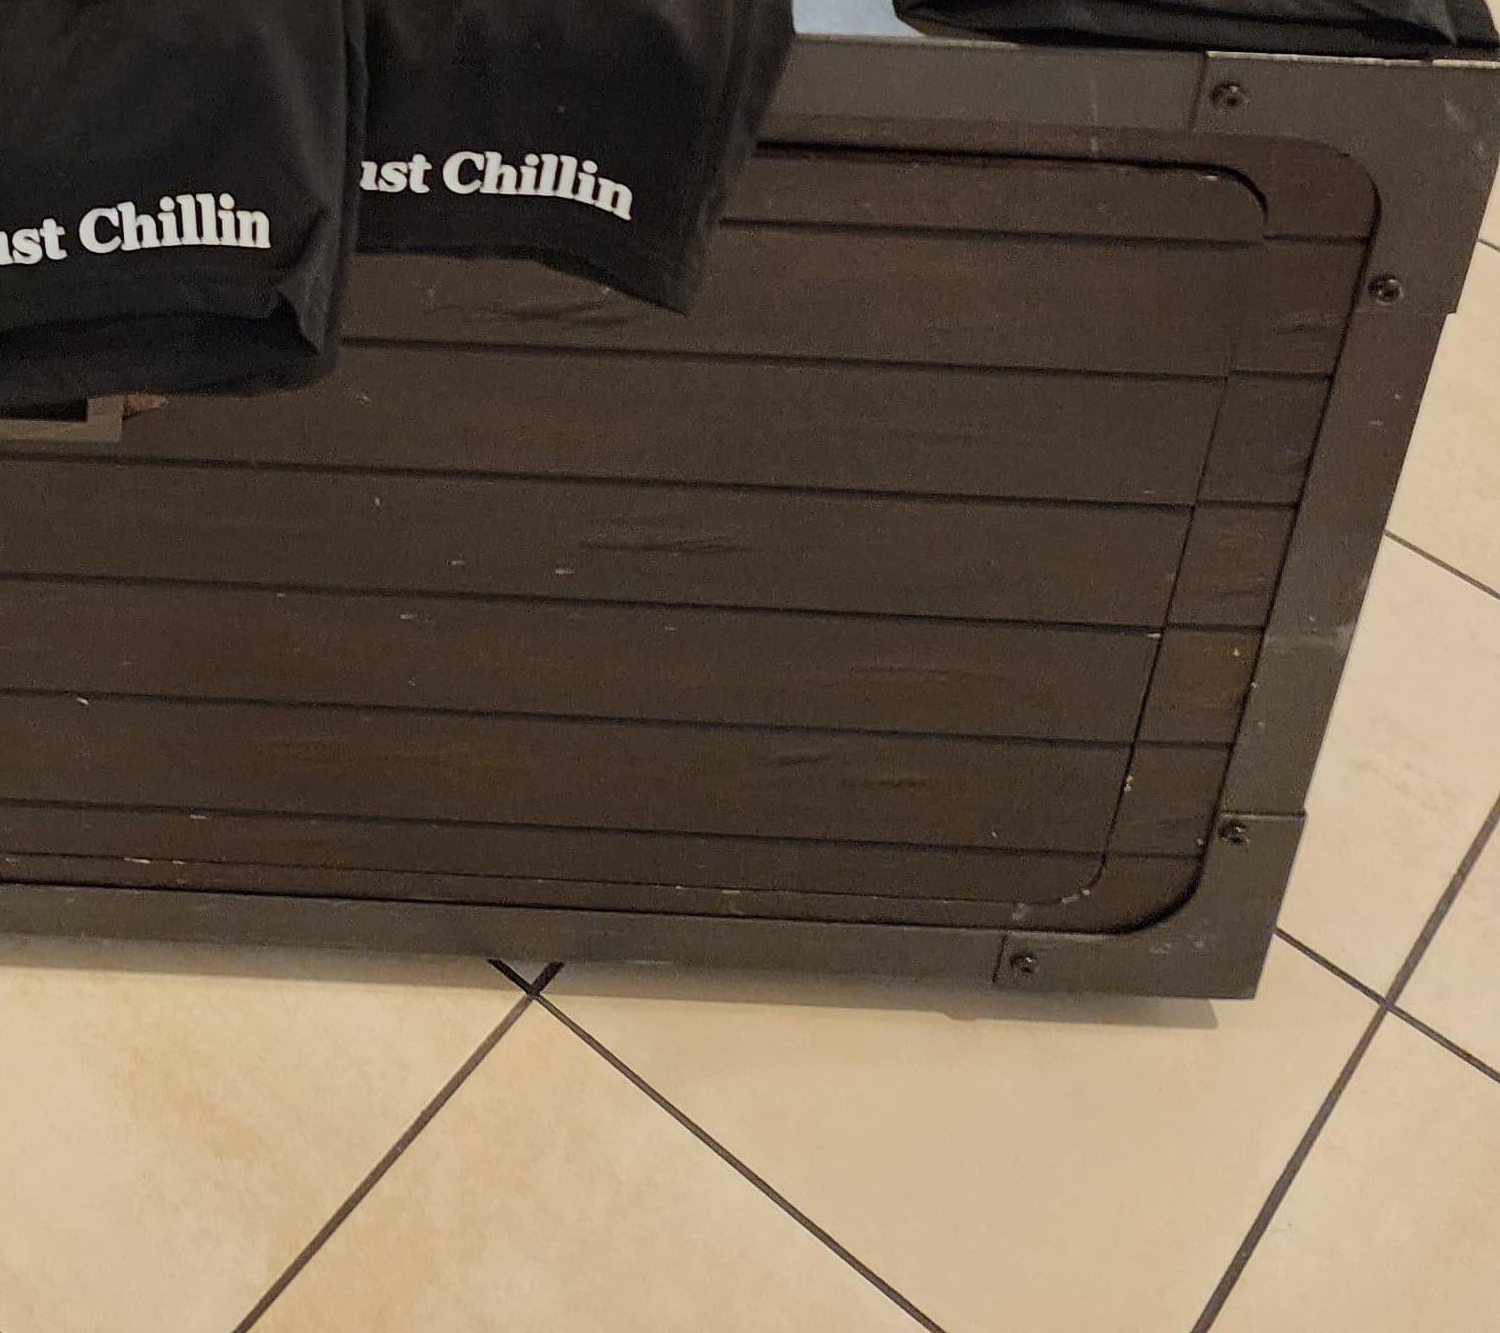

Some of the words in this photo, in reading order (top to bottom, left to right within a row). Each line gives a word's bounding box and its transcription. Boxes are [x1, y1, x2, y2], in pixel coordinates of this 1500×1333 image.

[359, 152, 433, 194] st
[441, 150, 633, 221] Chillin
[78, 192, 272, 254] Chillin
